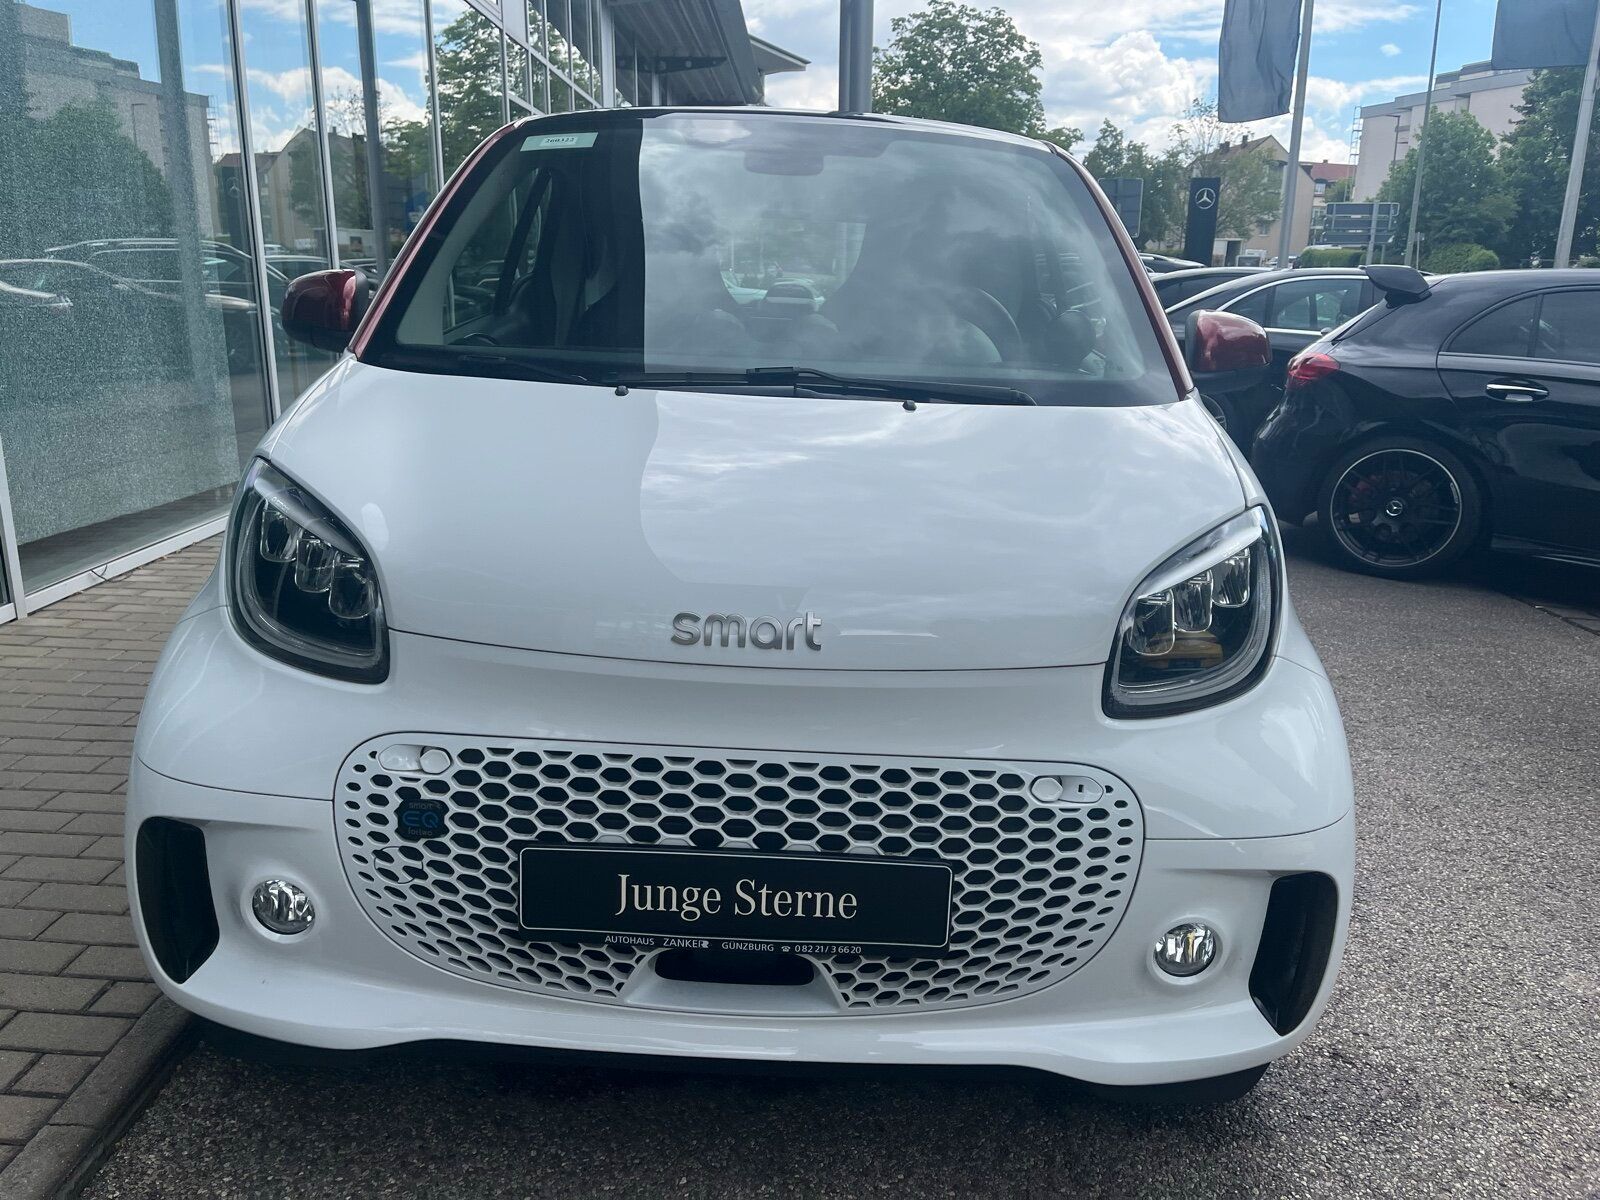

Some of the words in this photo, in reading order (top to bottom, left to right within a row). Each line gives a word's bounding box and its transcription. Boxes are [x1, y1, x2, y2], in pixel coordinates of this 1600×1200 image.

[671, 612, 822, 651] smart
[403, 810, 439, 828] EQ
[615, 874, 722, 921] Junge
[734, 879, 857, 919] Sterne
[604, 935, 655, 946] AUTOHAUS
[721, 941, 774, 951] GÜNZBURG
